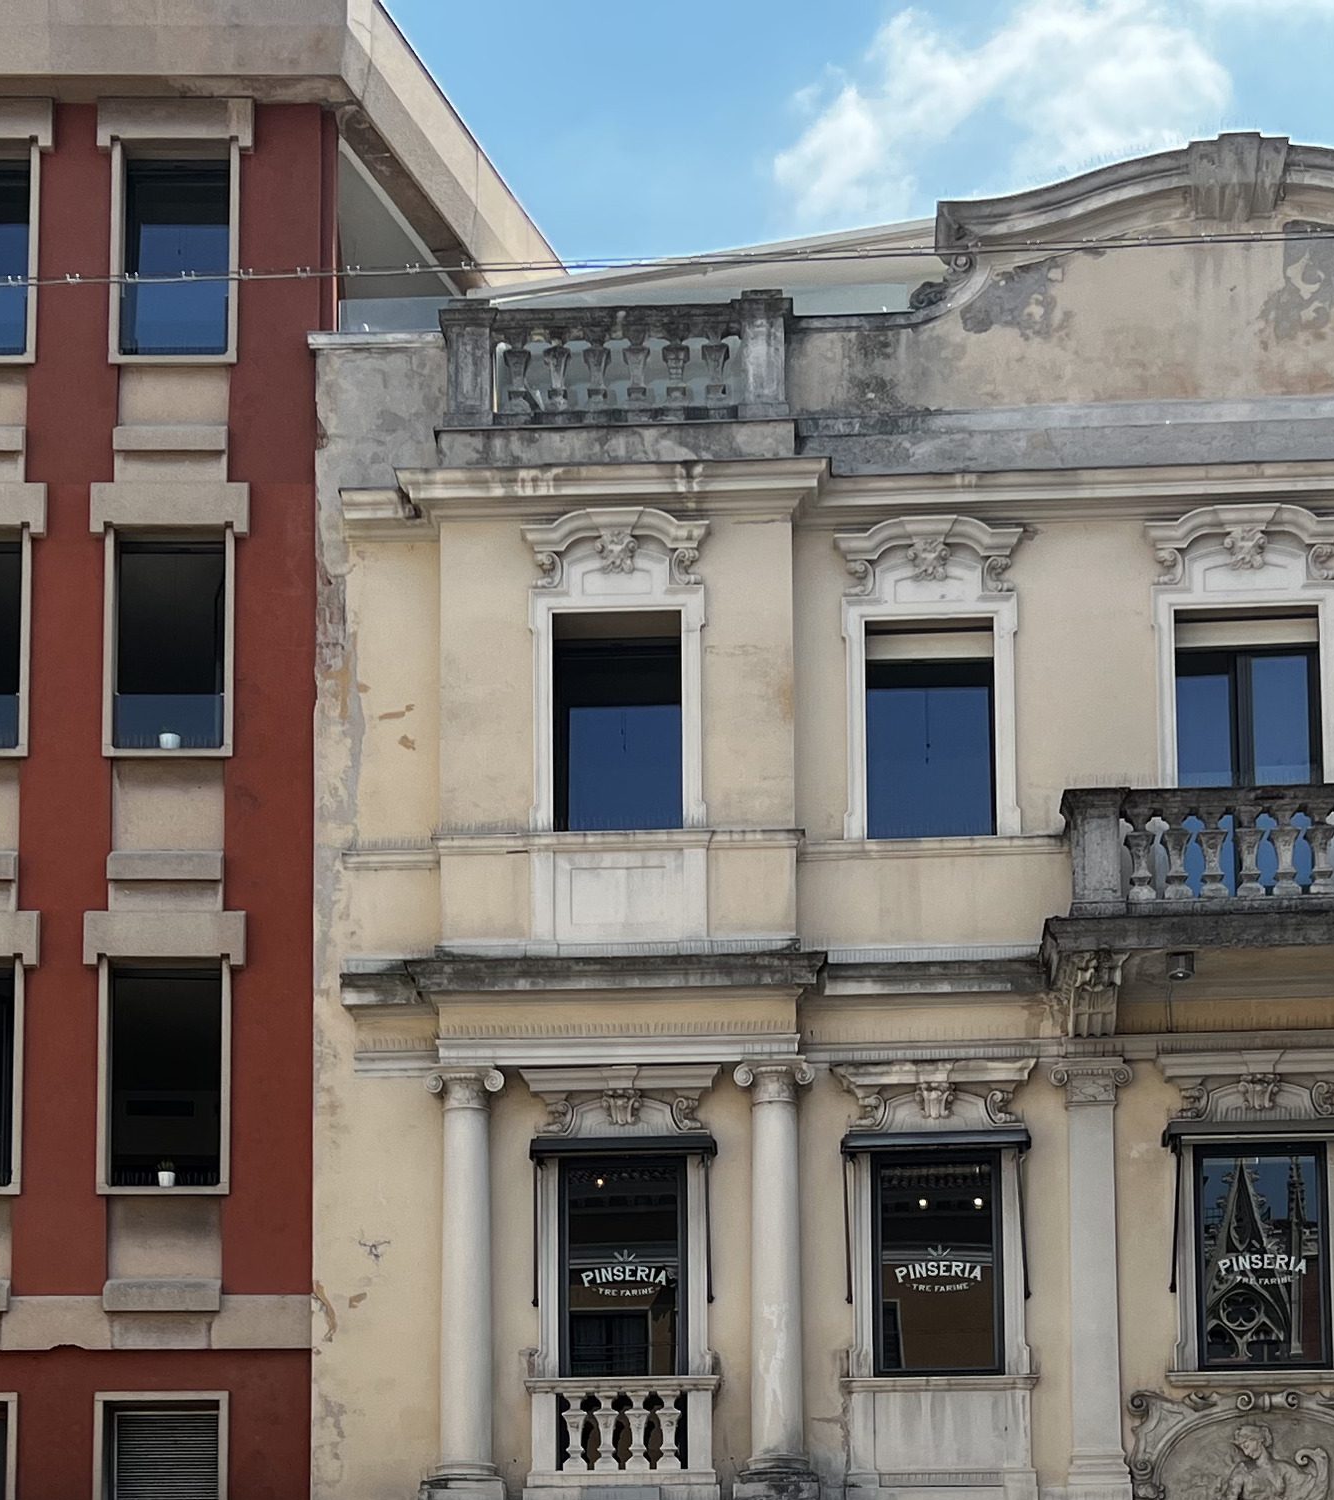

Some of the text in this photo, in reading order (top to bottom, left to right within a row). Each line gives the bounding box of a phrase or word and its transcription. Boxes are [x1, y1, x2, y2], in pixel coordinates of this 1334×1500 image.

[894, 1261, 982, 1283] PINSERIA
[1217, 1253, 1307, 1275] PINSERIA
[581, 1265, 667, 1287] PINSERIA
[598, 1286, 655, 1298] TRE FARINE
[912, 1282, 969, 1293] TRE FARINE
